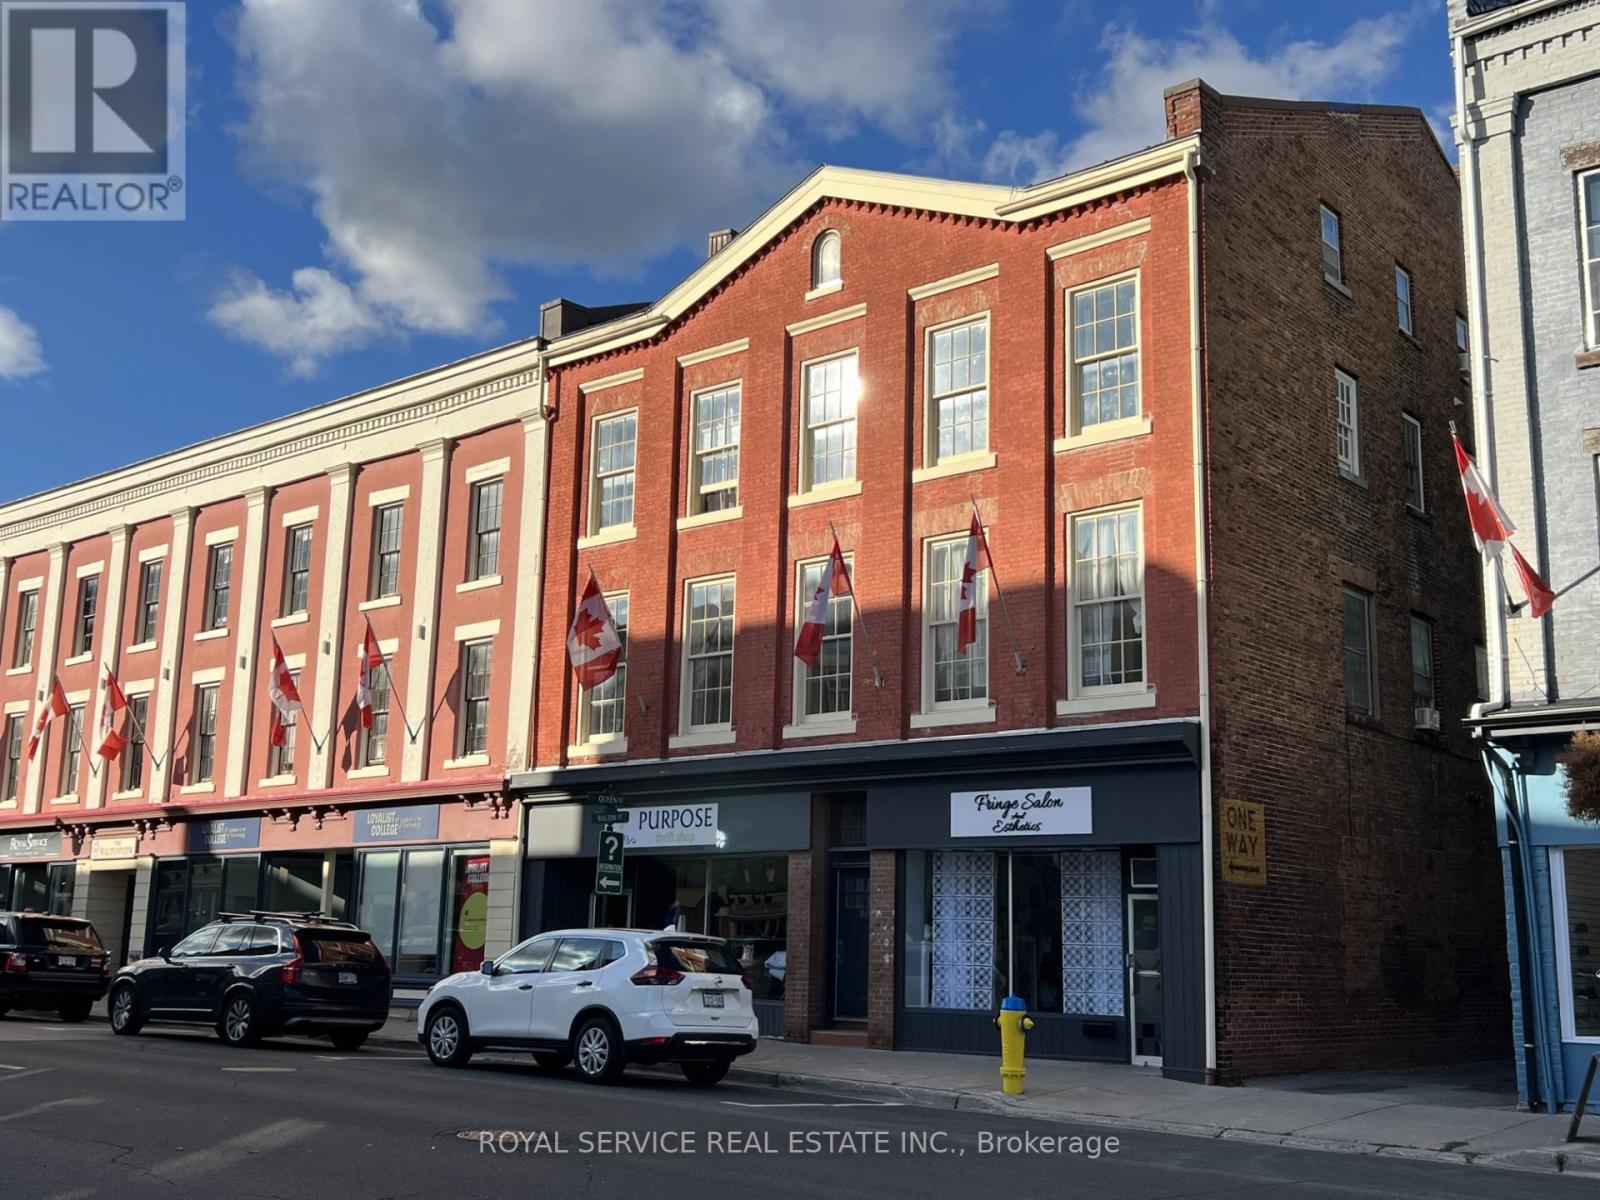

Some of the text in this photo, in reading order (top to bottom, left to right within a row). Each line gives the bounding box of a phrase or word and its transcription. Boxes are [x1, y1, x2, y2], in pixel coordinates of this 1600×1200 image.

[598, 795, 617, 804] QUEEN
[974, 791, 1064, 819] Fringe Salon
[367, 811, 397, 825] LOYALIST
[639, 807, 713, 830] PURPOSE
[1226, 806, 1257, 832] ONE
[371, 823, 399, 836] COLLEGE
[992, 819, 1042, 833] Esthetics
[677, 830, 696, 844] shop
[1225, 831, 1259, 858] WAY
